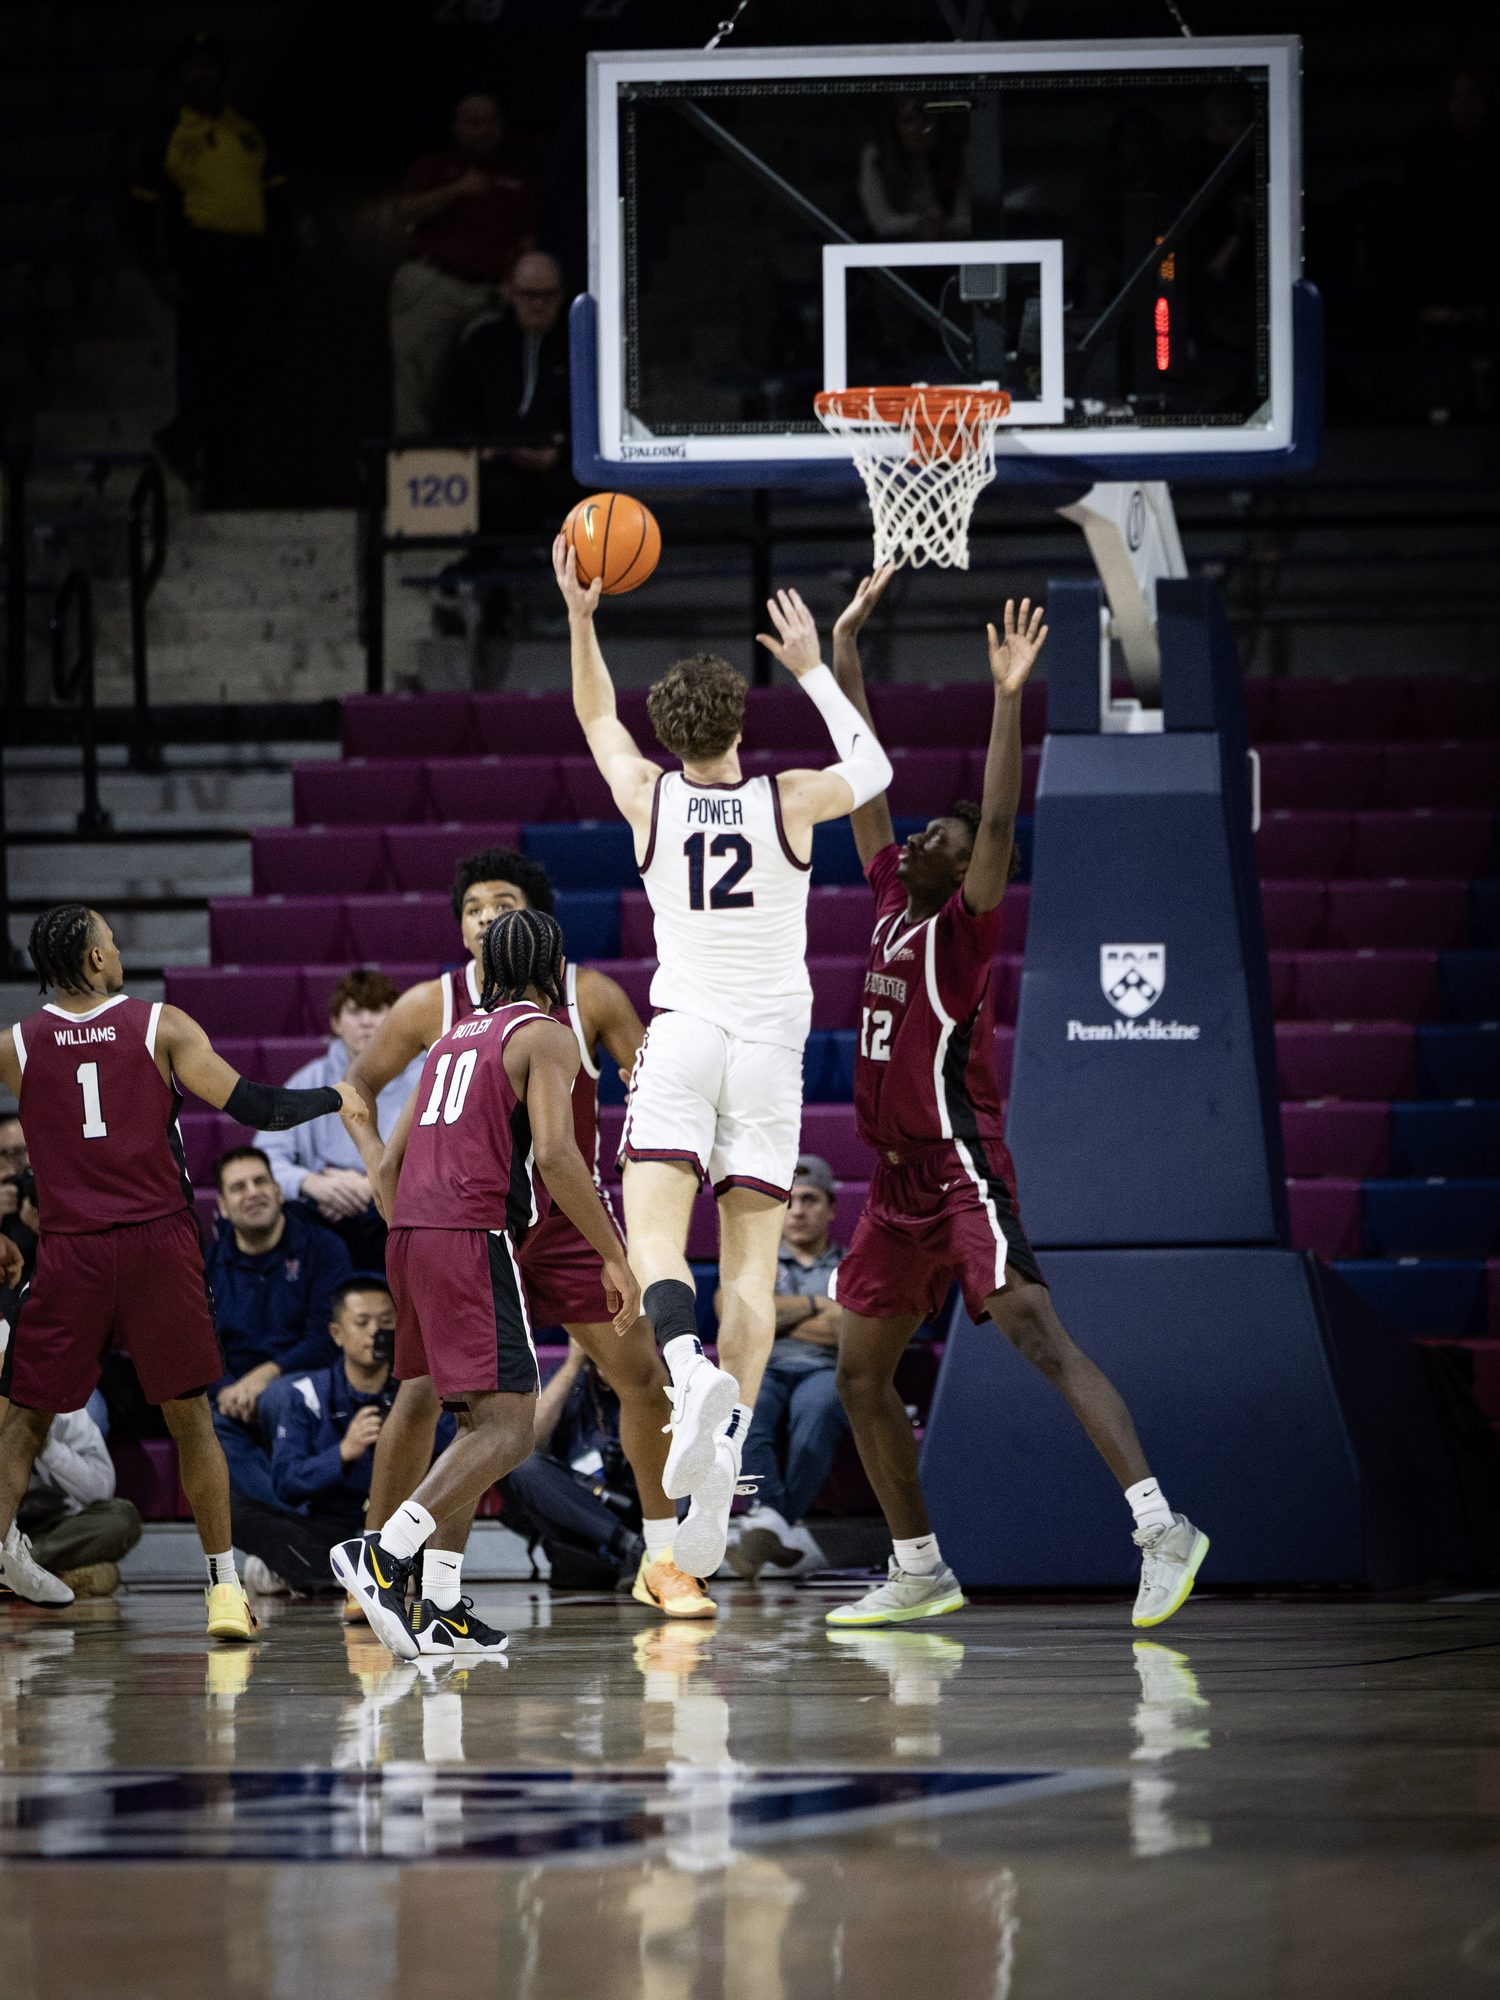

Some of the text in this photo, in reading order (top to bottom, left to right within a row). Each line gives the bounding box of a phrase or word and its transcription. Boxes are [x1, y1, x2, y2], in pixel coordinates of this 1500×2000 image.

[620, 445, 687, 459] SPALDING
[408, 474, 469, 507] 120
[687, 797, 743, 826] POWER
[683, 832, 754, 911] 12
[54, 1026, 117, 1046] WILLIAMS
[452, 1018, 493, 1040] BUTLER
[861, 1006, 893, 1062] 12
[1067, 1018, 1200, 1041] Penn Medicine
[76, 1062, 108, 1139] 1
[419, 1048, 478, 1126] 10
